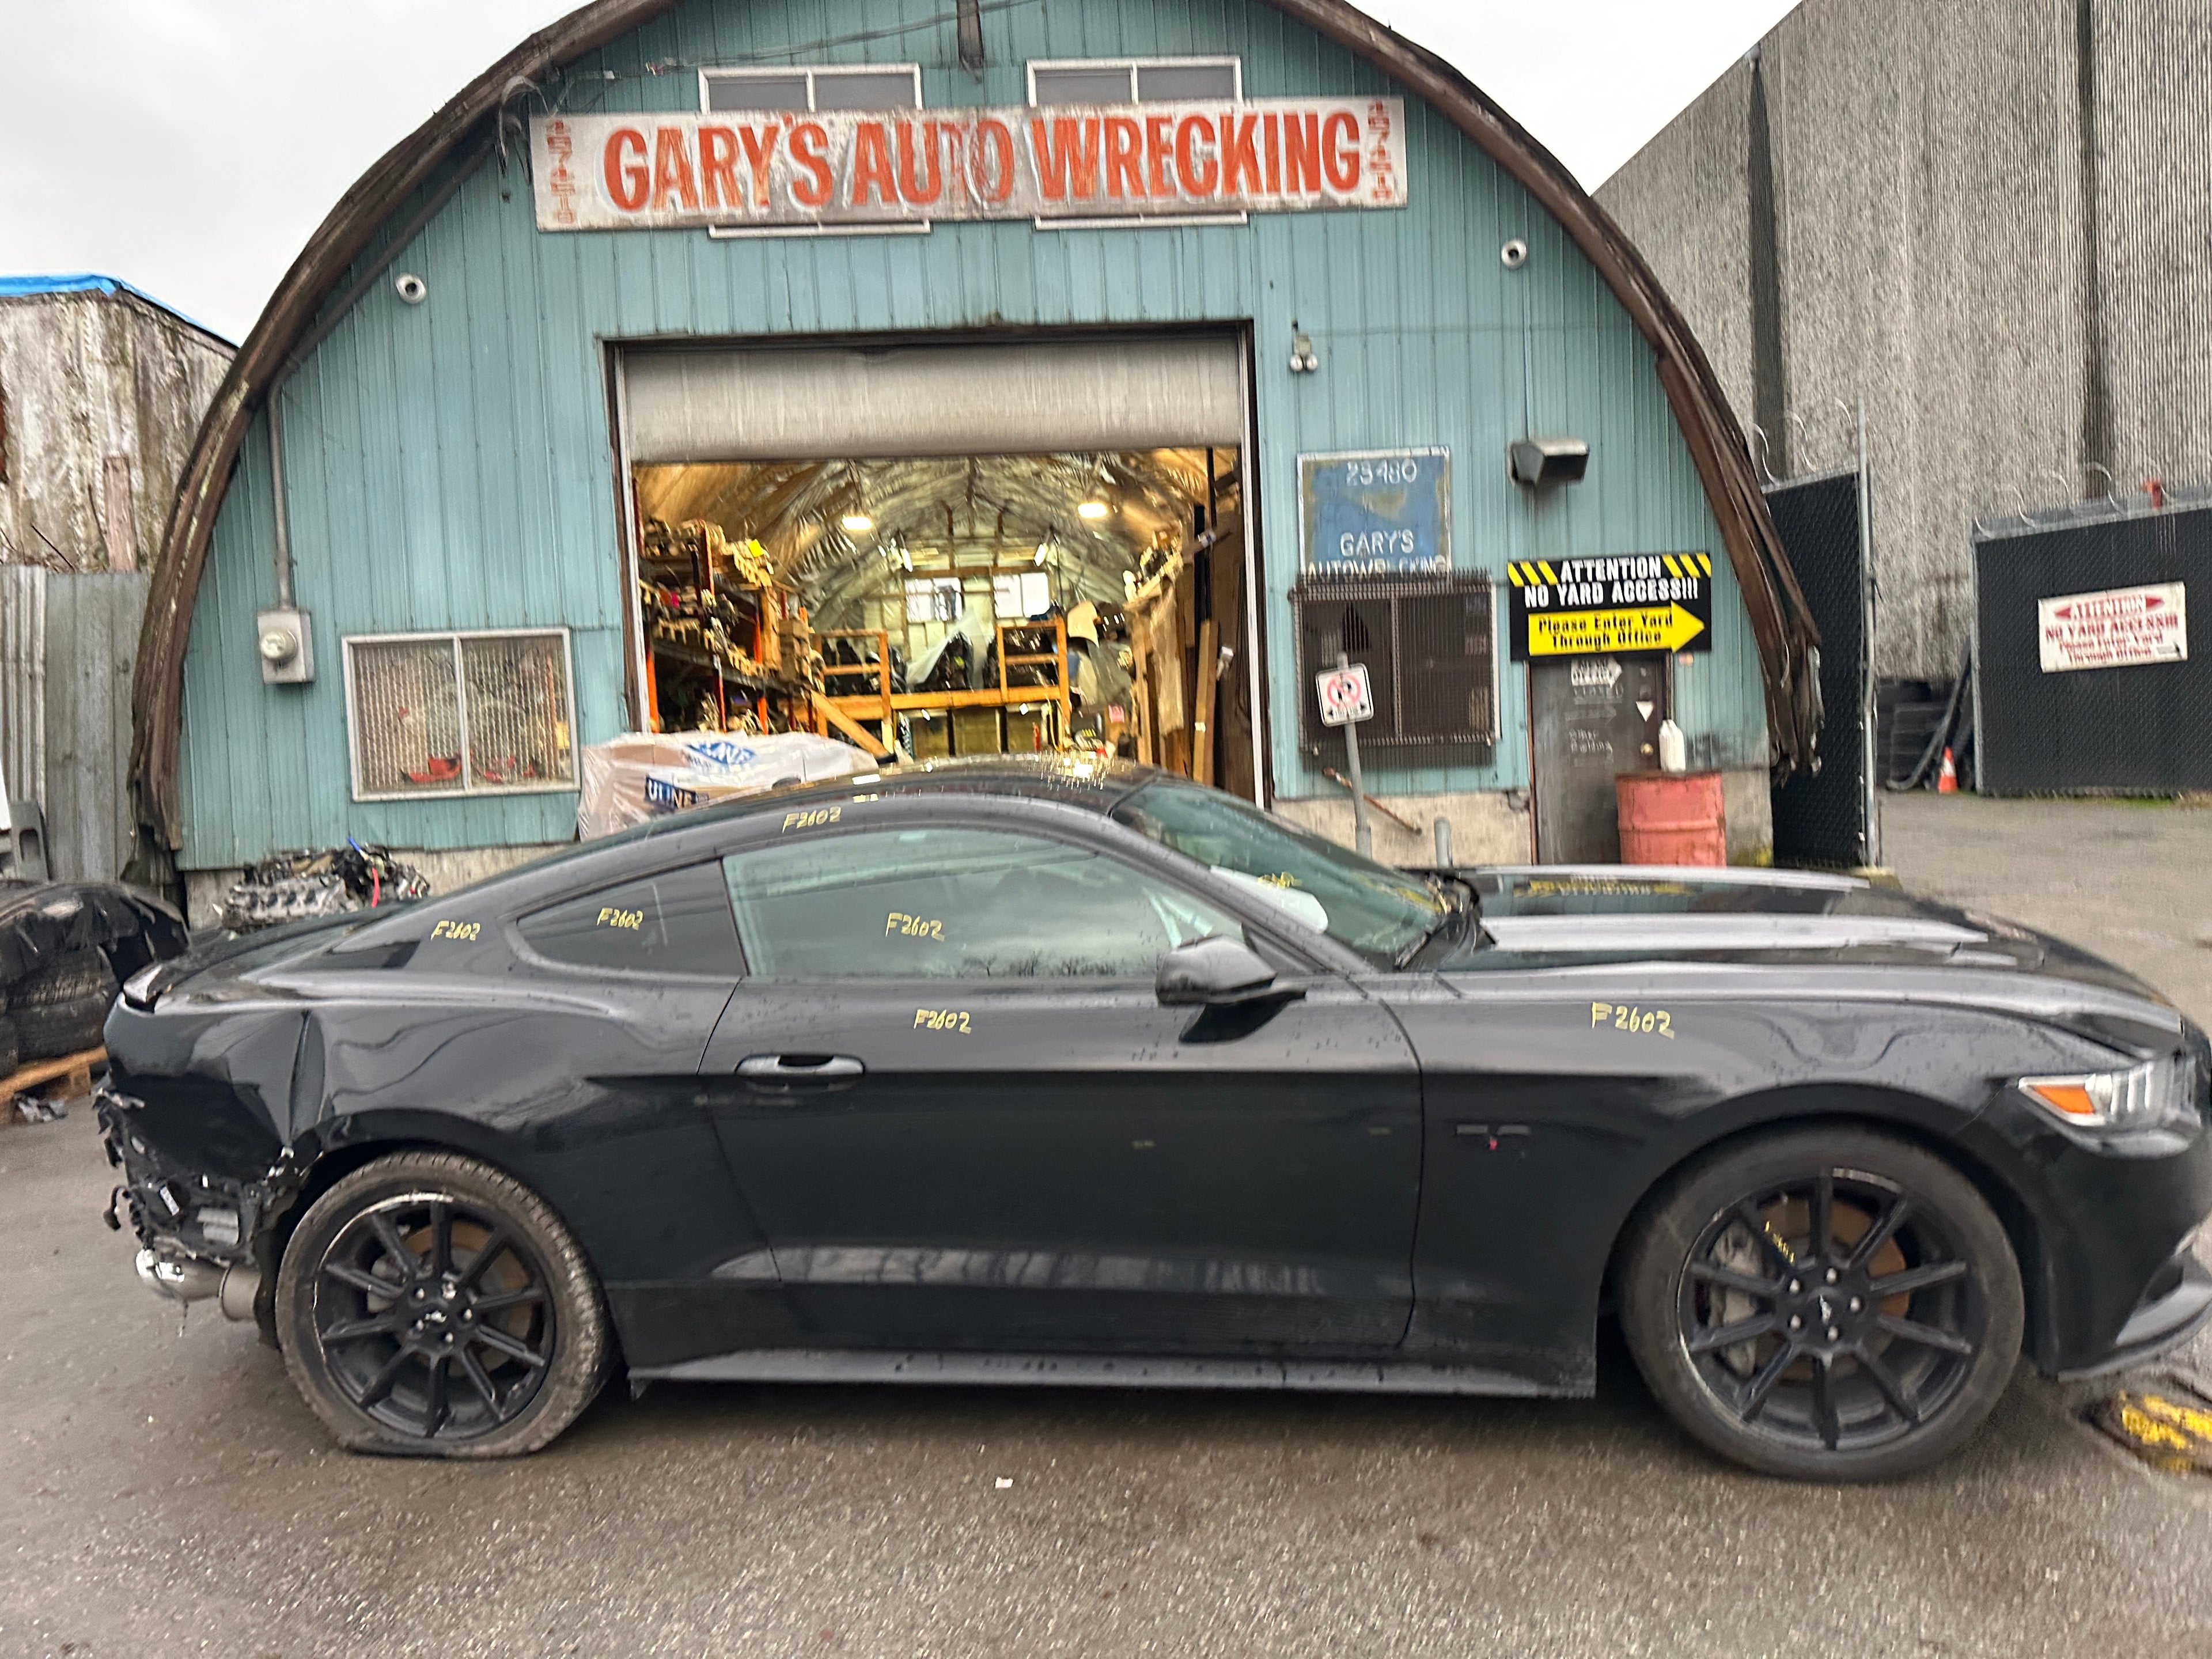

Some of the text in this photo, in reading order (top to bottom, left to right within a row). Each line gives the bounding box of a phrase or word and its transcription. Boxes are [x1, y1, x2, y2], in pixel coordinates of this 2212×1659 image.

[603, 115, 833, 212] GARY'S
[851, 118, 1015, 206] AUTO
[1031, 109, 1360, 200] WRECKING
[1340, 529, 1414, 557] GARY'S
[1560, 555, 1662, 582] ATTENTION
[1524, 576, 1699, 608] NO YARD ACCESS!!!
[1539, 609, 1673, 635] Please Enter Yard
[1552, 628, 1661, 652] Through Office
[782, 806, 842, 833] F2602
[430, 921, 481, 941] F2602
[597, 907, 644, 930] F2602
[885, 912, 945, 942] F2602
[914, 1009, 972, 1035] F2602
[1592, 1001, 1675, 1040] F2602
